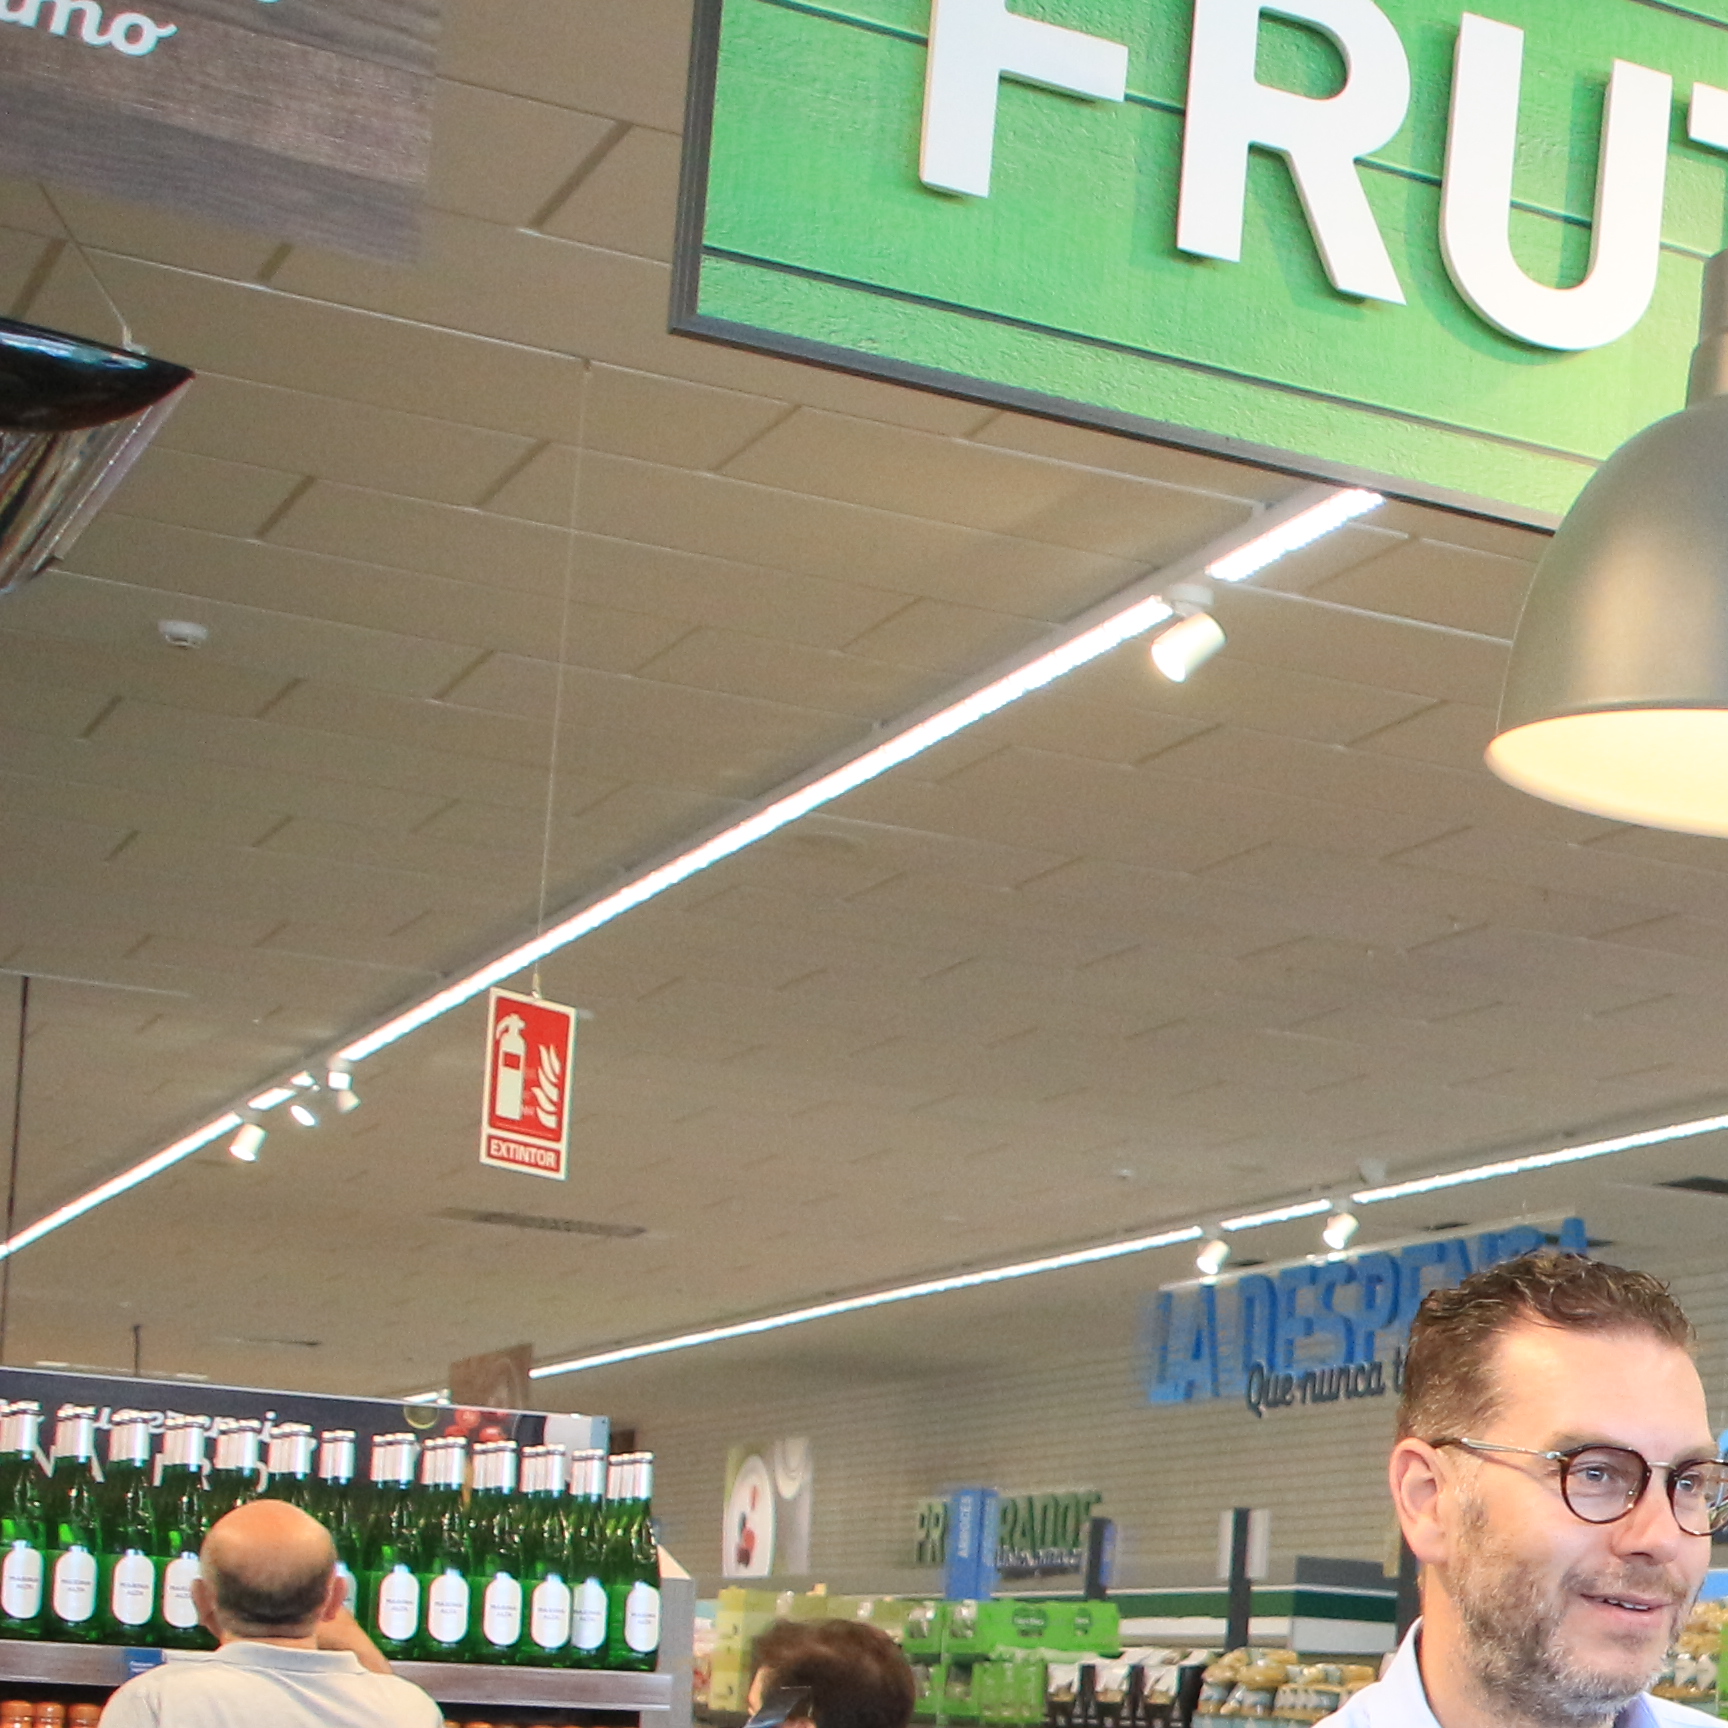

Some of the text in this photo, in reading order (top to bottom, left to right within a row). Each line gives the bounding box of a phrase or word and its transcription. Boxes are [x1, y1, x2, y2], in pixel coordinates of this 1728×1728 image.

[489, 1138, 558, 1168] EXTINTOR
[1247, 1361, 1295, 1418] Que
[1302, 1360, 1386, 1402] nunca
